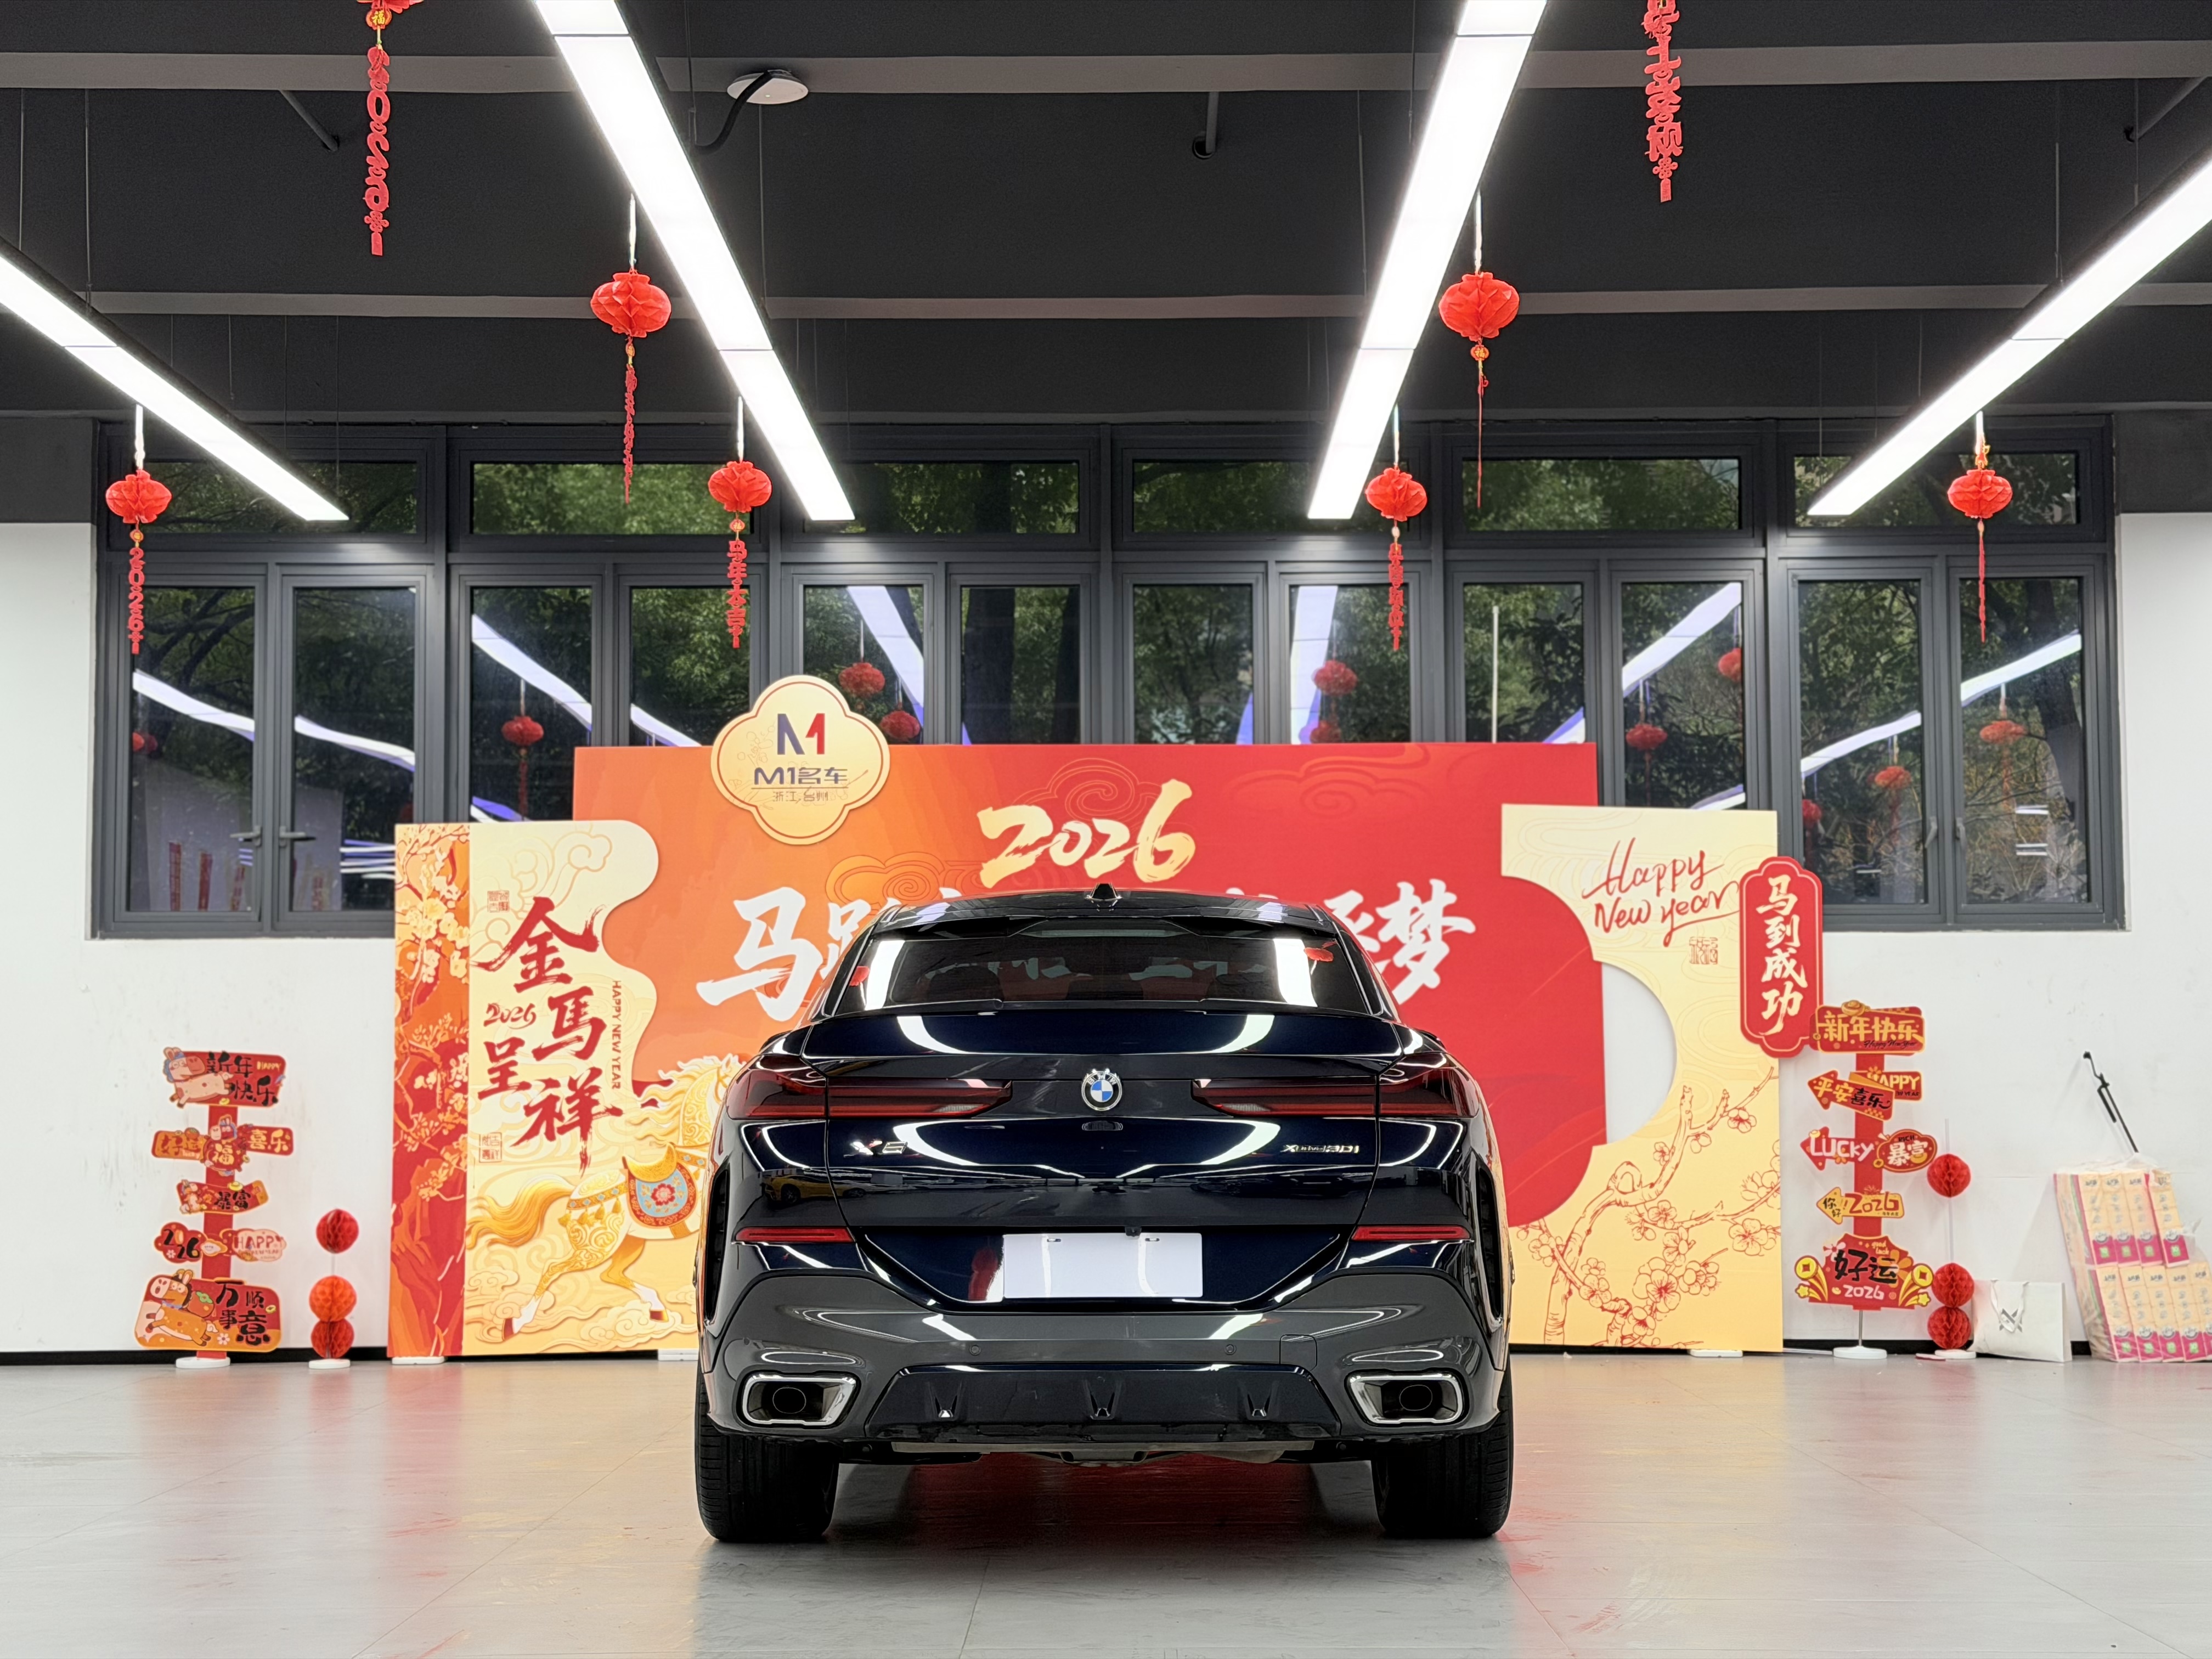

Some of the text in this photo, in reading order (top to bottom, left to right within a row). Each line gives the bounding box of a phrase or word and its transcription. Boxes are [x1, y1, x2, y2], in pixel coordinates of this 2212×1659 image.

[372, 10, 386, 25] 福
[128, 548, 145, 632] 2026
[727, 541, 747, 627] 马年大吉
[977, 778, 1195, 889] 2026
[1582, 837, 1724, 899] Happy
[1594, 896, 1651, 933] New
[1756, 874, 1808, 1036] 马到成功
[483, 1002, 537, 1029] 2026
[1824, 1011, 1925, 1042] 新年快乐
[612, 980, 622, 1090] HAPPY NEW YEAR
[1087, 1073, 1117, 1085] BMW
[1845, 1192, 1899, 1214] 2026
[1834, 1249, 1898, 1284] 好运
[1843, 1284, 1884, 1300] 2026
